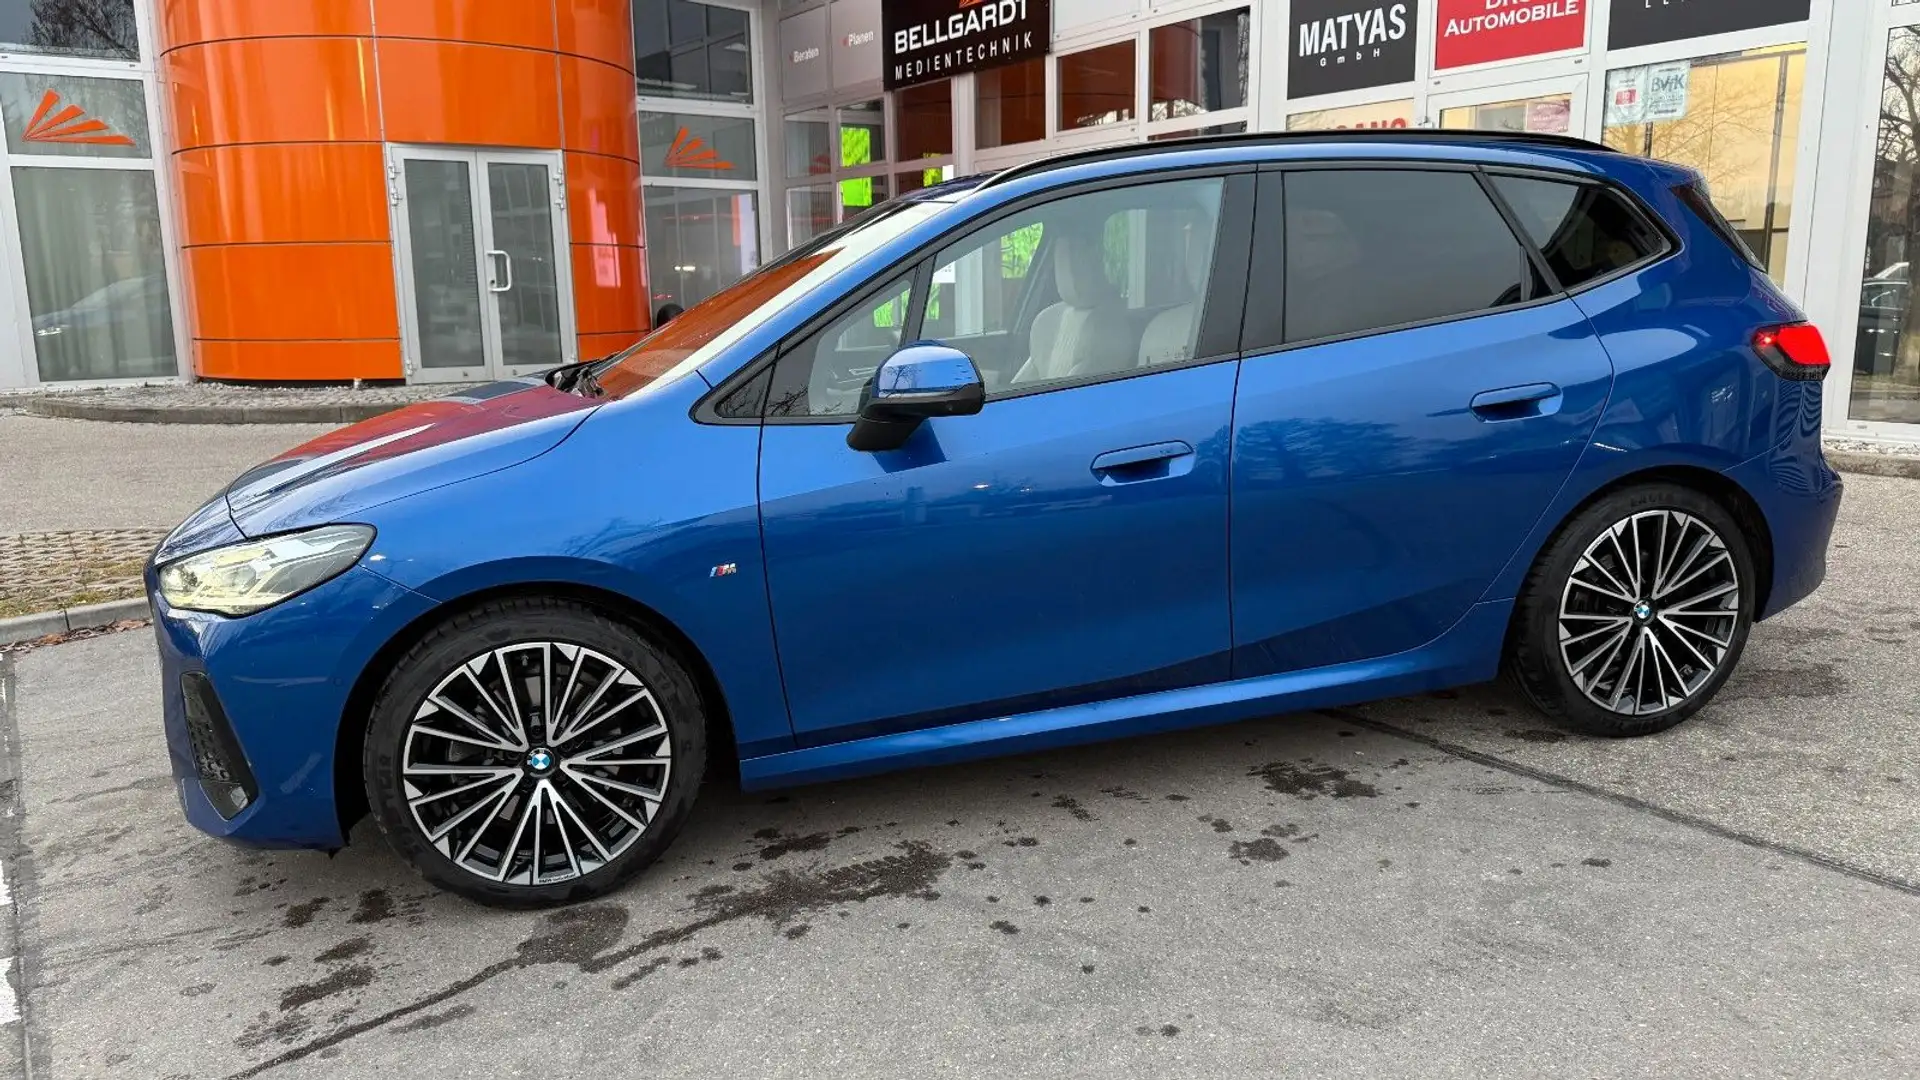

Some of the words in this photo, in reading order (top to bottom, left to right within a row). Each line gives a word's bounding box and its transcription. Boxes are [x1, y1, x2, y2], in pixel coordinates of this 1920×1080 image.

[847, 31, 874, 47] Planen
[895, 0, 1027, 54] BELLGARDT
[1299, 3, 1406, 57] MATYAS
[1444, 0, 1579, 37] AUTOMOBILE
[895, 31, 1032, 80] MEDIENTECHNIK
[1320, 47, 1380, 67] GmbH
